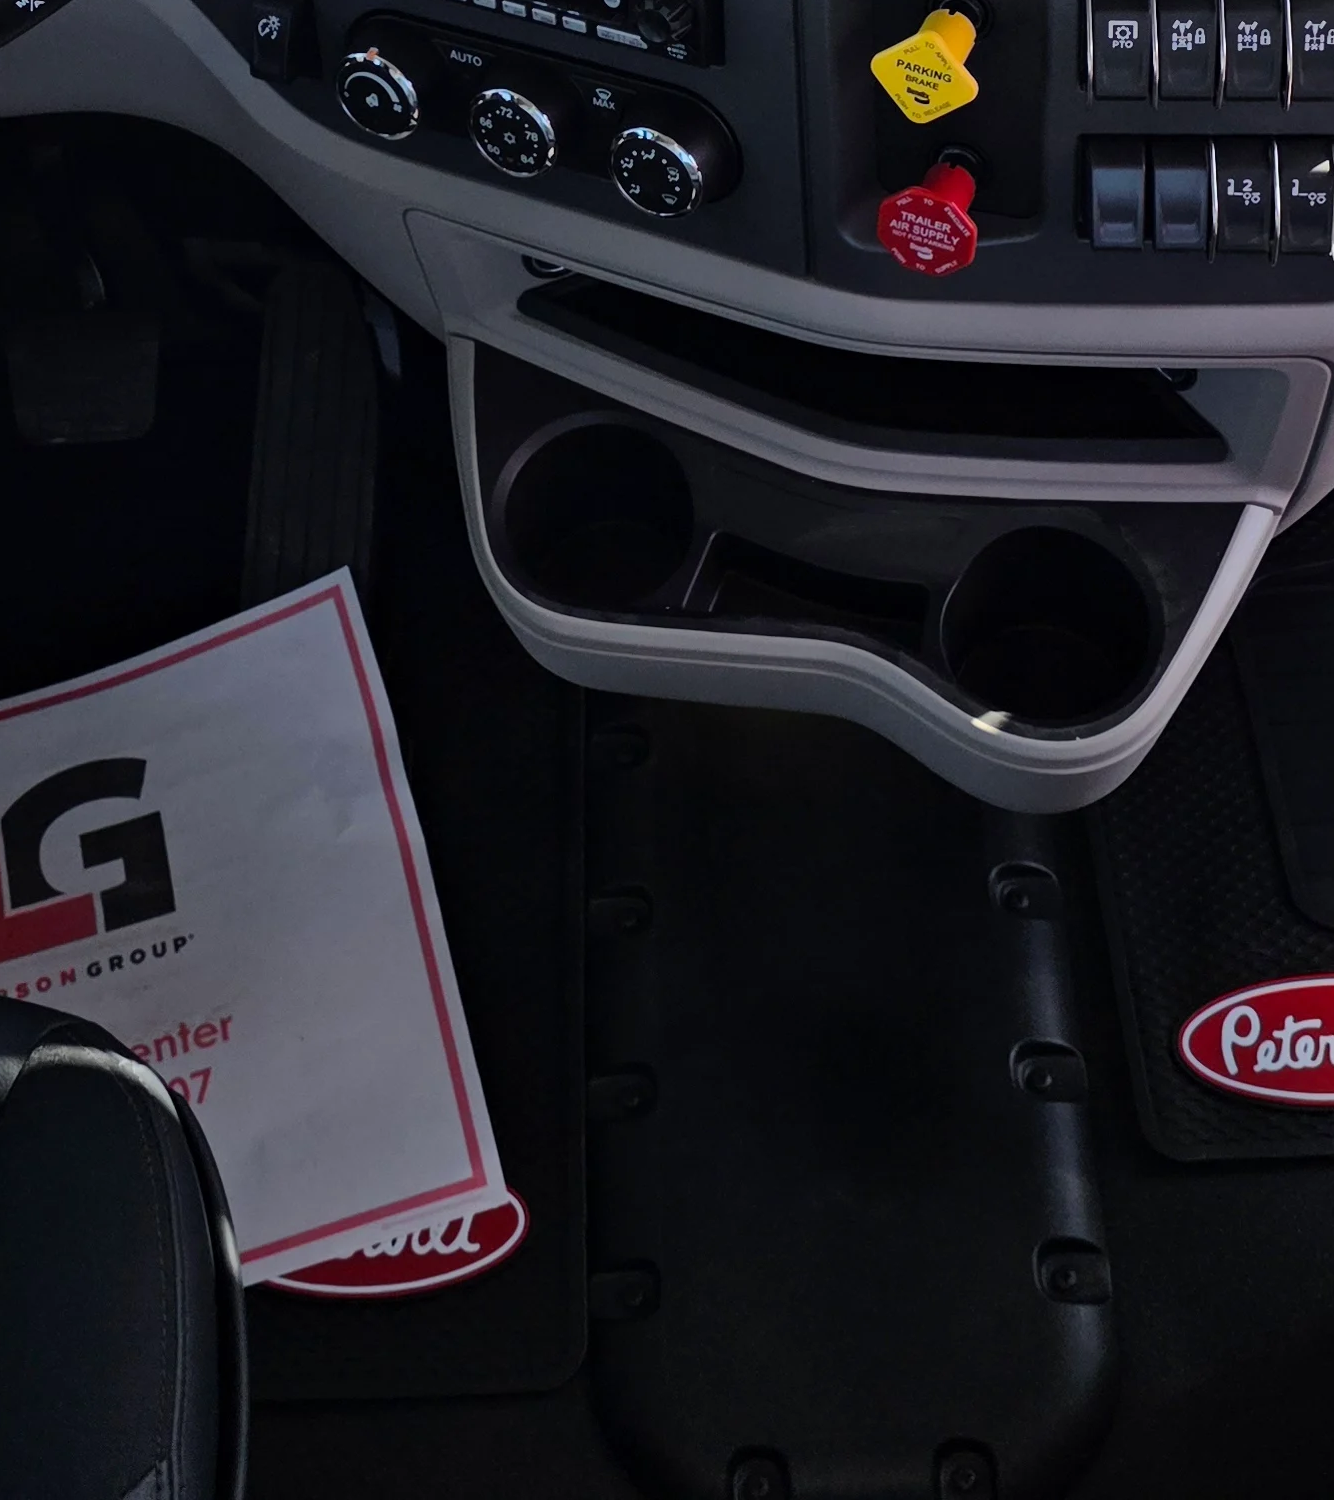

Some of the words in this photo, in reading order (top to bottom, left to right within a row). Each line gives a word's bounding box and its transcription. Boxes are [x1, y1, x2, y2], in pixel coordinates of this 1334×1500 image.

[1112, 40, 1134, 49] PTO
[450, 49, 483, 67] AUTO
[903, 45, 920, 55] PULL
[925, 41, 935, 50] TO
[935, 51, 952, 71] APPLY
[896, 59, 952, 83] PARKING
[905, 74, 939, 91] BRAKE
[592, 97, 616, 111] MAX
[923, 101, 952, 116] RELEASE
[499, 106, 514, 119] 72
[479, 116, 493, 130] 66
[524, 130, 539, 143] 78
[520, 154, 535, 165] 84
[1242, 179, 1253, 191] 2
[923, 198, 934, 206] TO
[901, 210, 951, 233] TRAILER
[889, 219, 910, 232] AIR
[912, 225, 960, 246] SUPPLY
[892, 229, 907, 238] NOT
[907, 233, 922, 243] FOR
[923, 238, 955, 252] PARKING
[915, 262, 926, 271] TO
[86, 935, 189, 979] GROUP
[129, 1015, 234, 1065] enter
